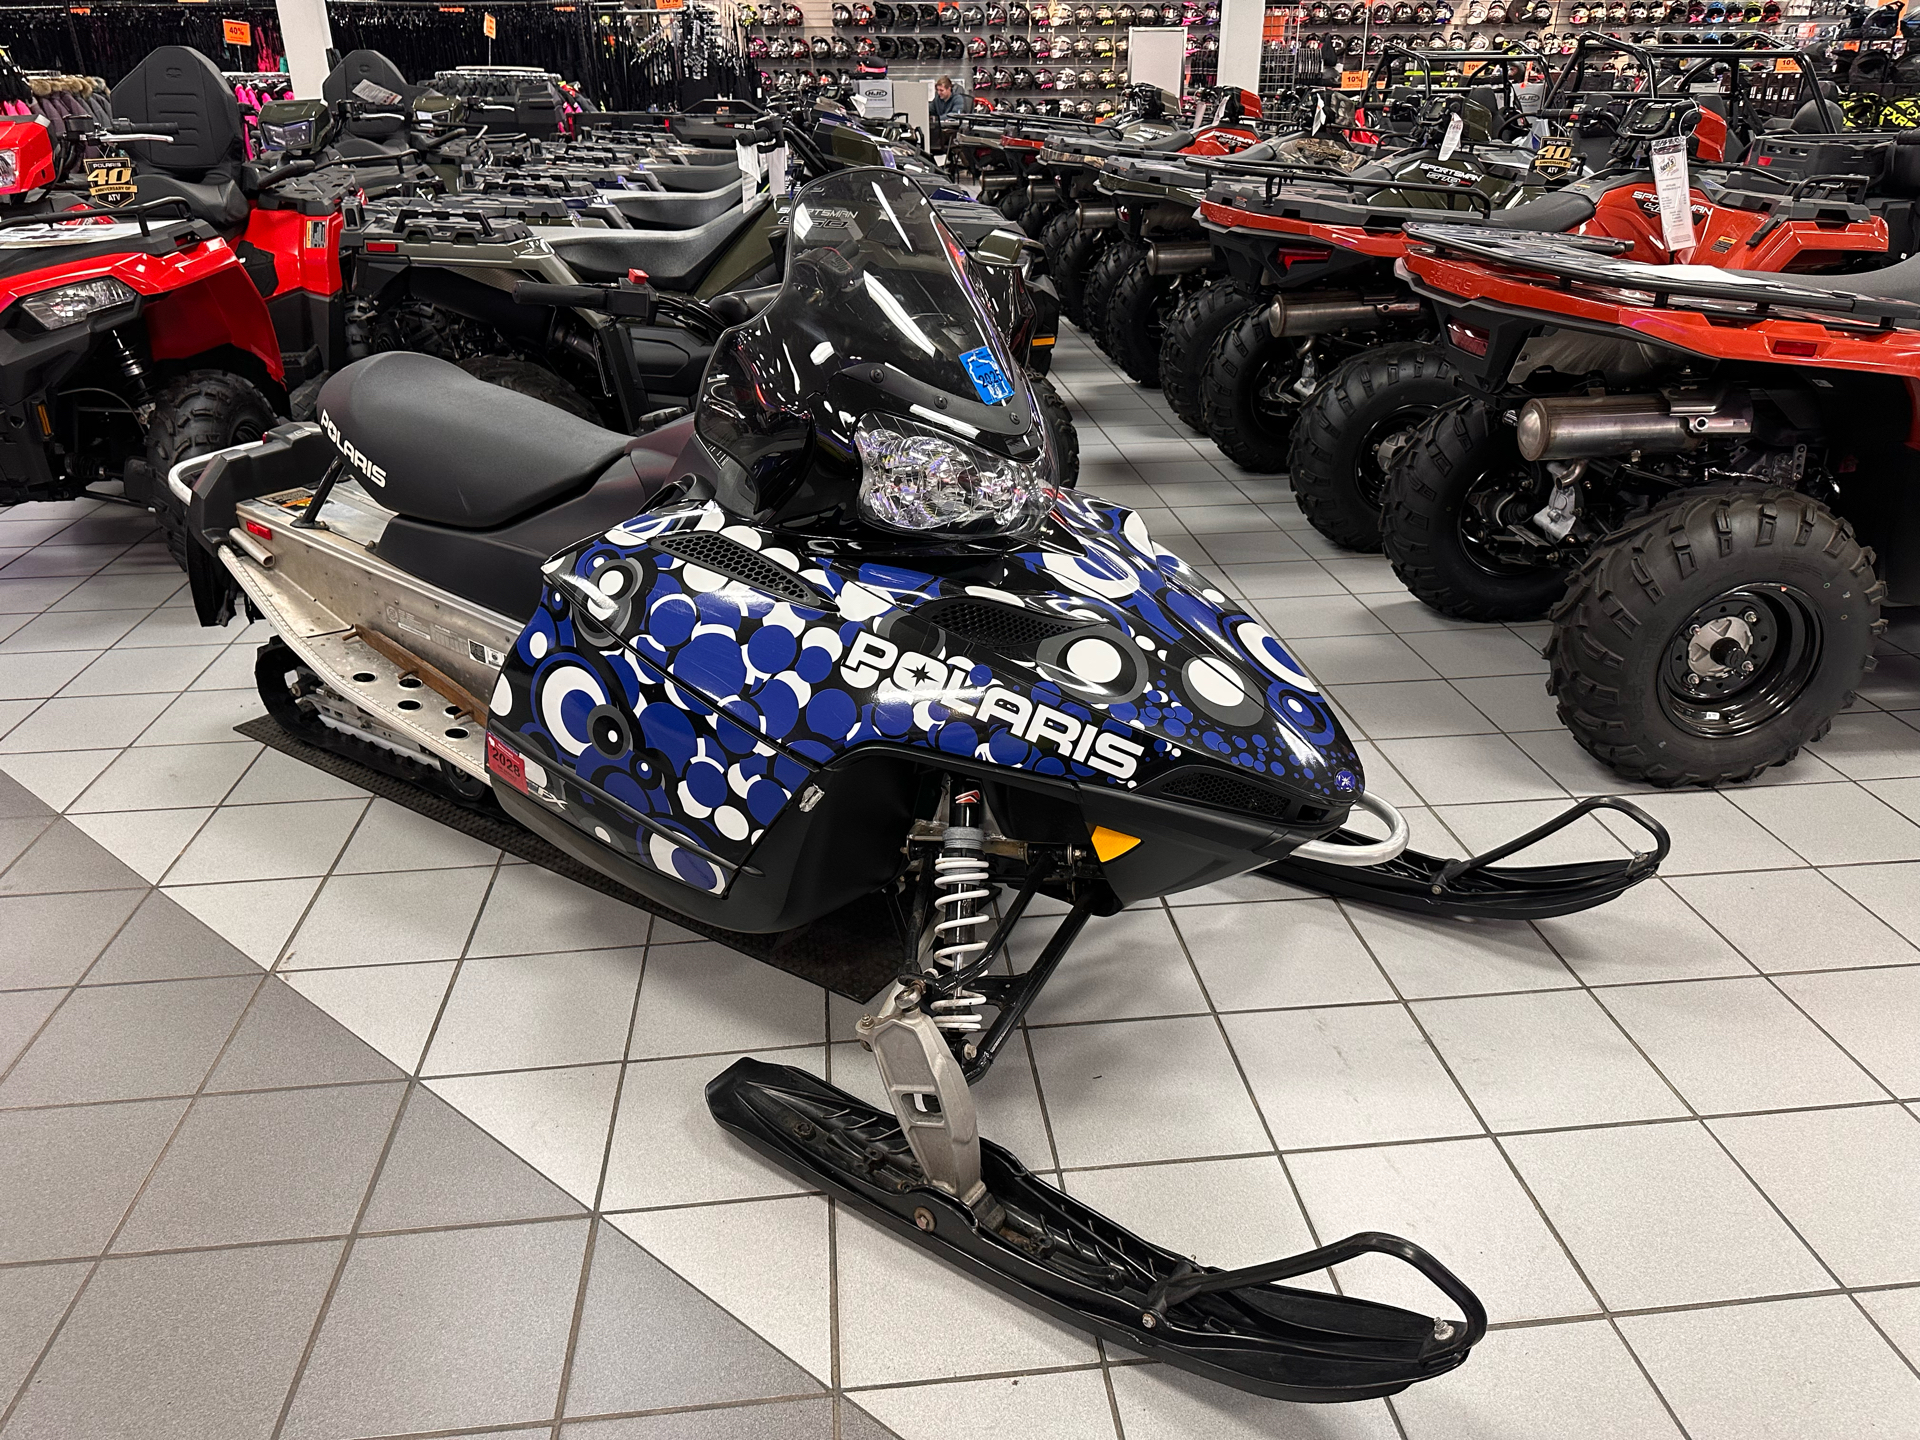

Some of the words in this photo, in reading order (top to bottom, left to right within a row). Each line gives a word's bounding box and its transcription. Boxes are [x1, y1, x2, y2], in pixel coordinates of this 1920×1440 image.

[1420, 163, 1485, 182] SPORTSMAN
[108, 194, 121, 202] ATV
[321, 409, 387, 488] POLARIS
[846, 631, 1145, 780] POLARIS
[492, 747, 521, 778] 2028
